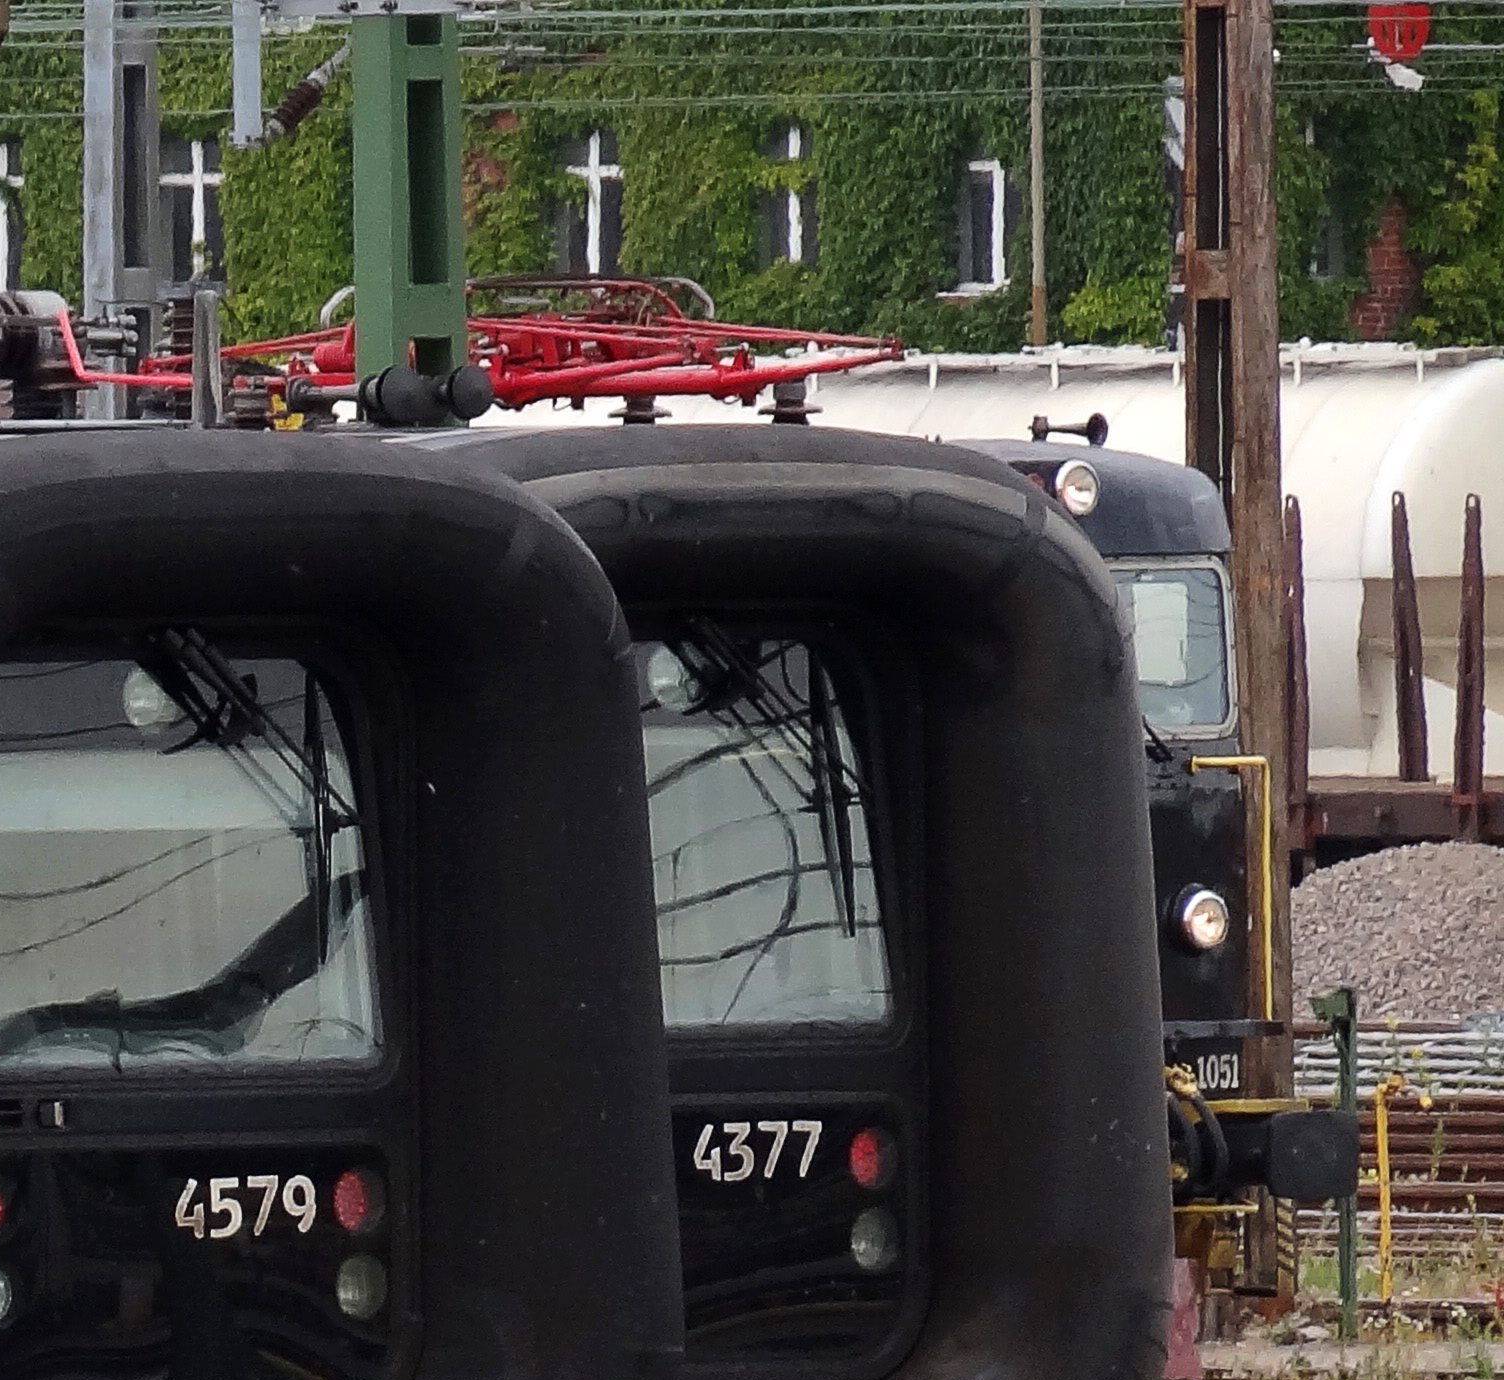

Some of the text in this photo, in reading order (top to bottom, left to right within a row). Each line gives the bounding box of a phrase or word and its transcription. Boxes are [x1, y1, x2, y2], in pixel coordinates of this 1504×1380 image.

[1197, 1053, 1240, 1090] 1051
[693, 1120, 823, 1182] 4377
[175, 1174, 317, 1239] 4579
